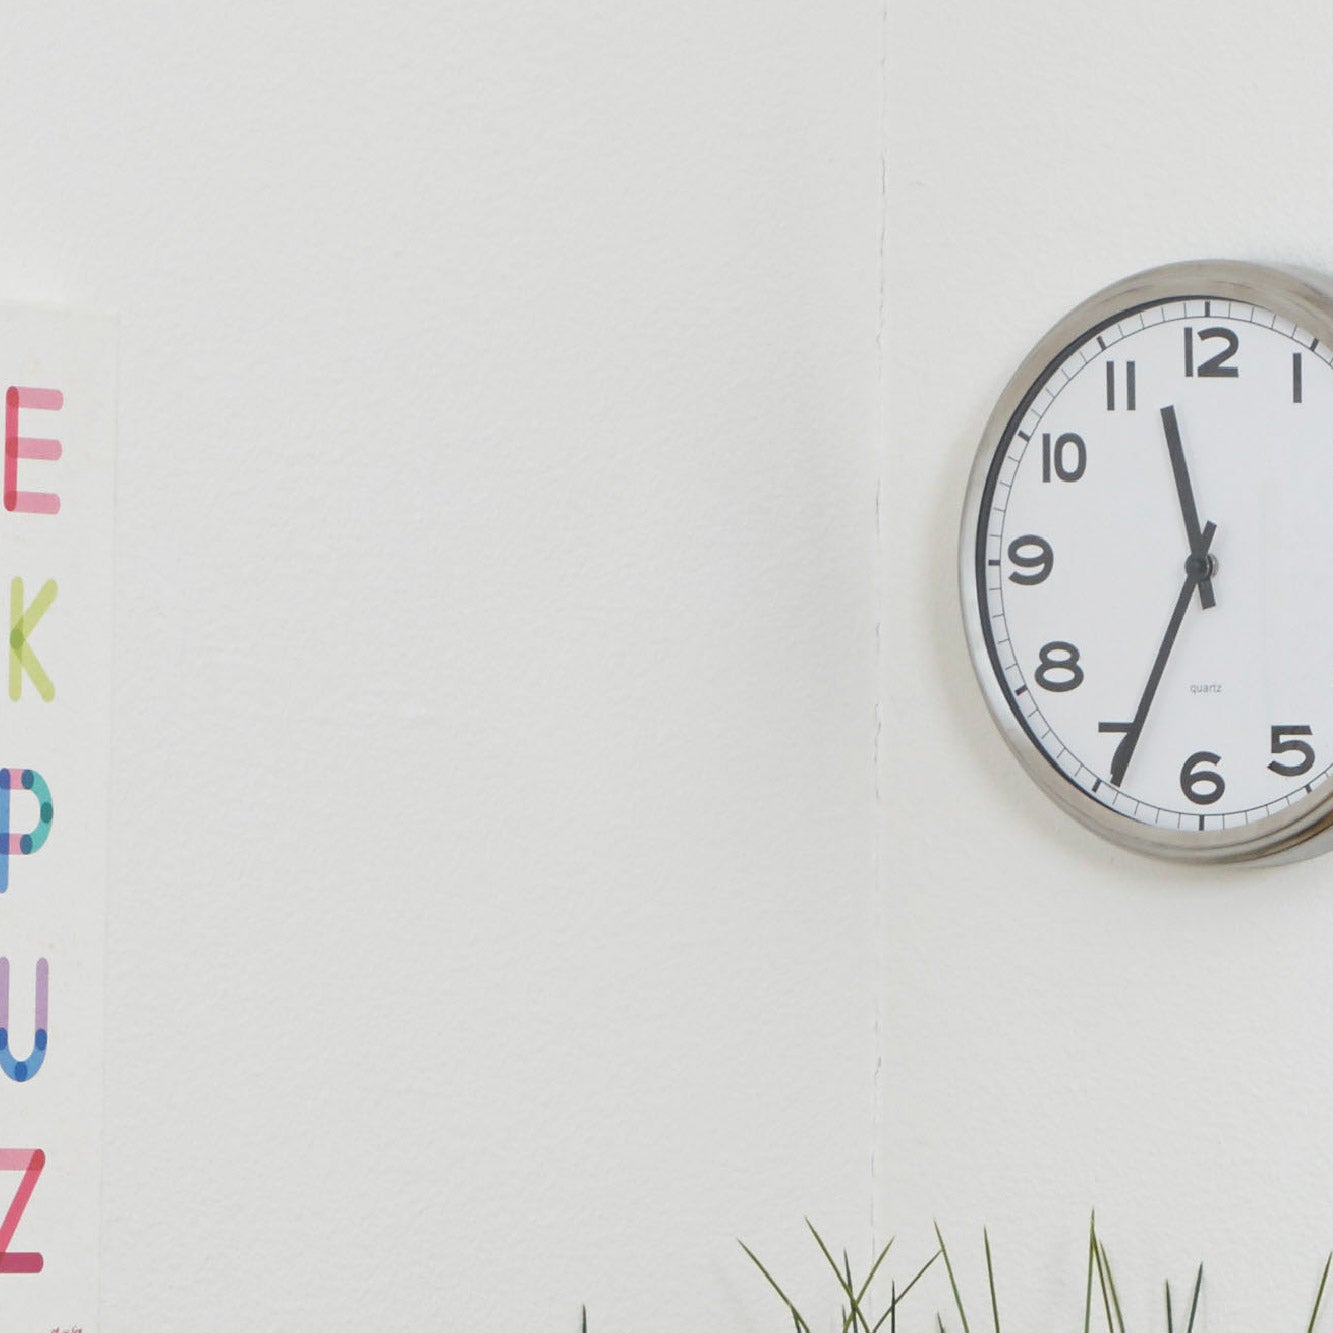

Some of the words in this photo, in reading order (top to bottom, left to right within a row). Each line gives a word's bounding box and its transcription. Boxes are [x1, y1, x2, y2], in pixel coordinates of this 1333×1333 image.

[1184, 327, 1240, 378] 12
[1292, 353, 1302, 404] 1
[1106, 360, 1136, 411] 11
[4, 386, 63, 515] E
[1042, 433, 1088, 483] 10
[1007, 534, 1054, 586] 9
[8, 576, 58, 702] K
[1034, 641, 1084, 692] 8
[1267, 725, 1315, 777] 5
[1179, 751, 1226, 805] 6
[0, 768, 53, 893] P
[0, 957, 48, 1082] U
[0, 1149, 45, 1273] Z
